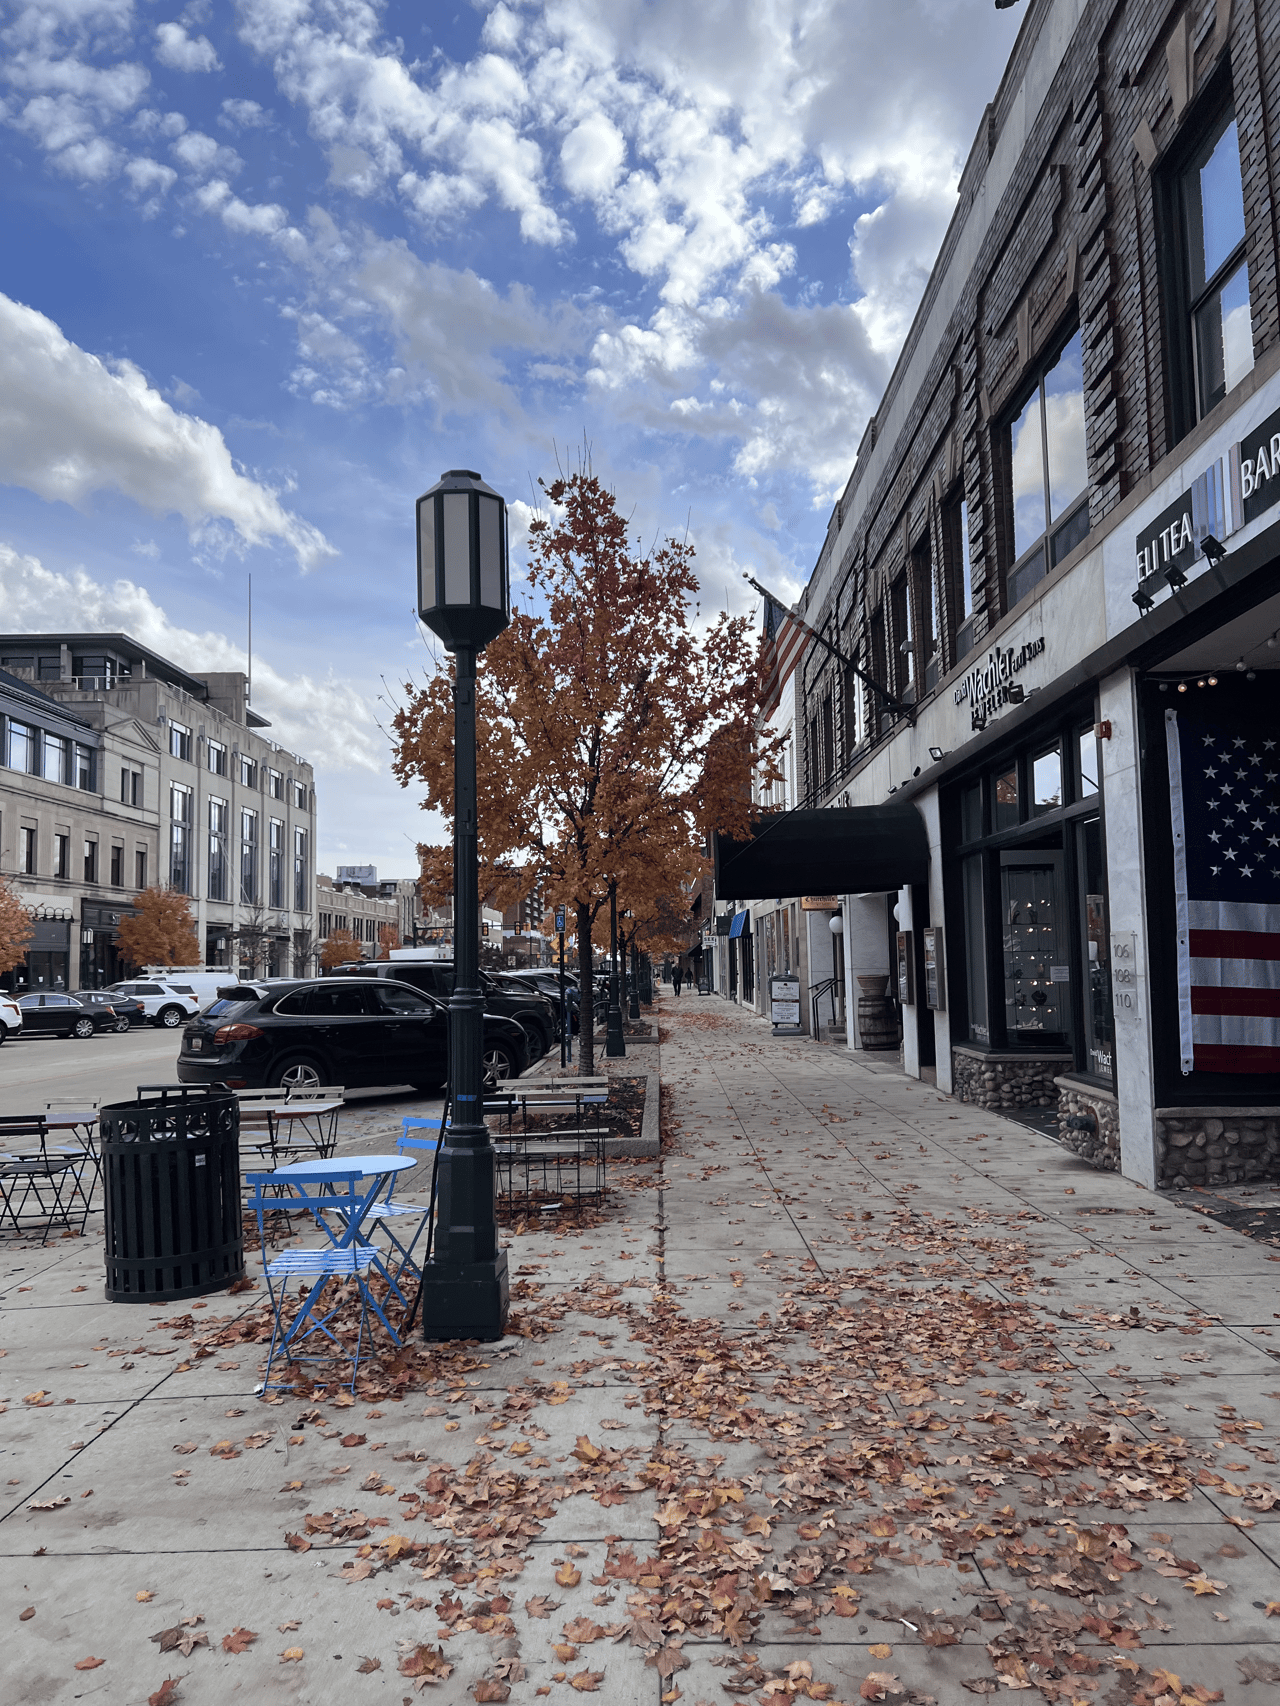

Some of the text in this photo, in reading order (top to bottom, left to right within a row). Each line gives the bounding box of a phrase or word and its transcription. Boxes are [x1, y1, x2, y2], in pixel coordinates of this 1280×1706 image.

[1137, 513, 1193, 584] ELI TEA
[966, 647, 1014, 707] Wachler
[1012, 646, 1026, 672] and
[1026, 636, 1045, 661] Sons
[1114, 944, 1129, 958] 106
[1114, 969, 1131, 983] 108
[1115, 994, 1132, 1008] 110
